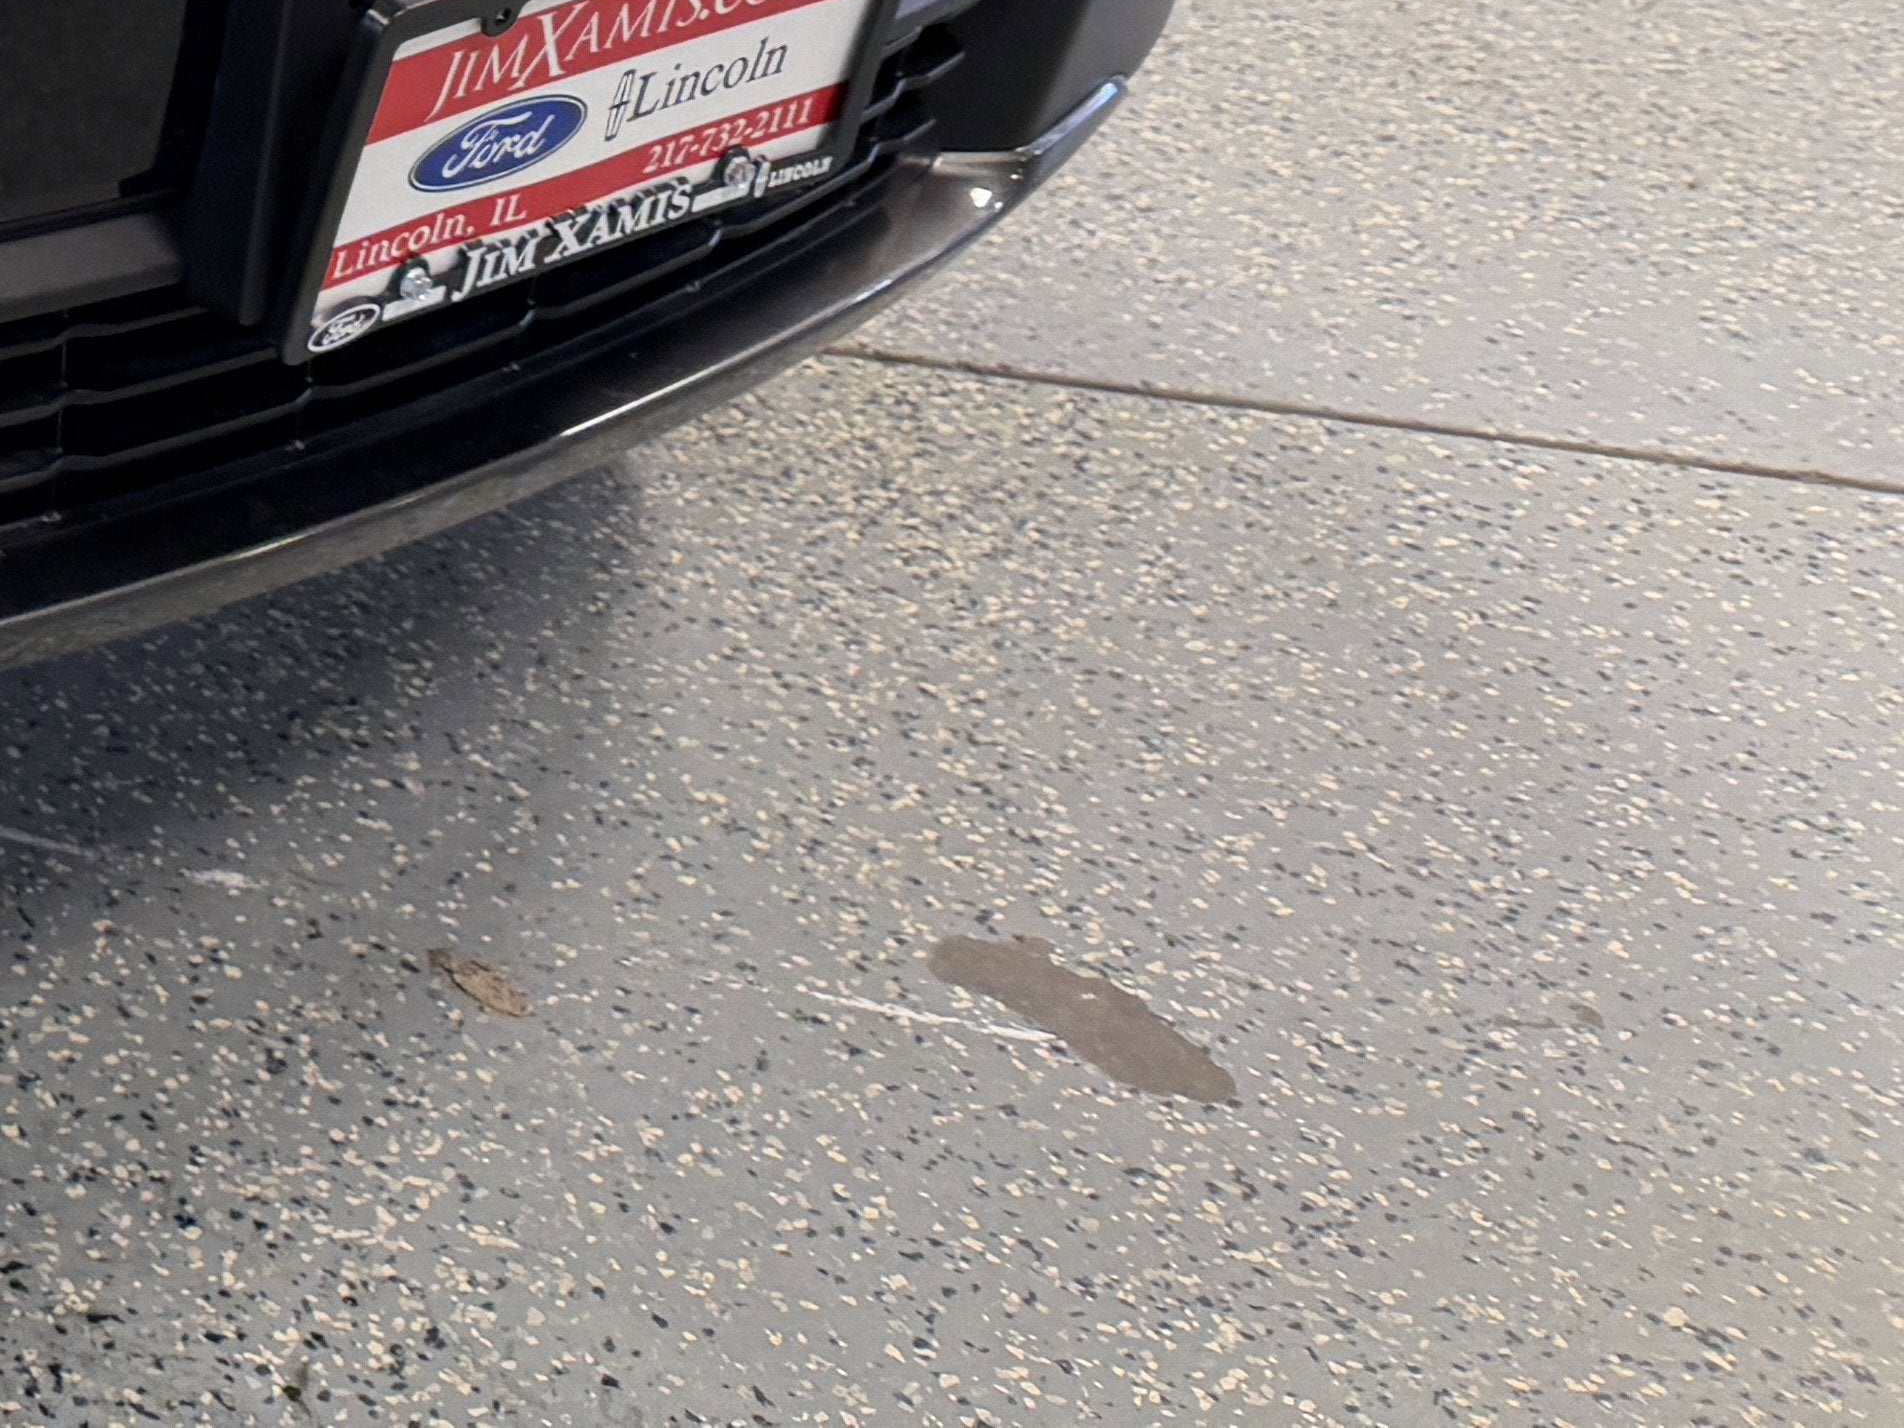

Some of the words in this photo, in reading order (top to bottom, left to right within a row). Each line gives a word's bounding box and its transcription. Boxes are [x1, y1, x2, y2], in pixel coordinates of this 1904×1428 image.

[625, 35, 789, 123] Lincoln
[442, 110, 556, 179] Ford
[642, 97, 814, 174] 217-732-2111
[331, 212, 475, 280] Lincoln,
[490, 193, 527, 227] IL
[451, 237, 541, 303] JIM
[543, 182, 693, 265] XAMIS
